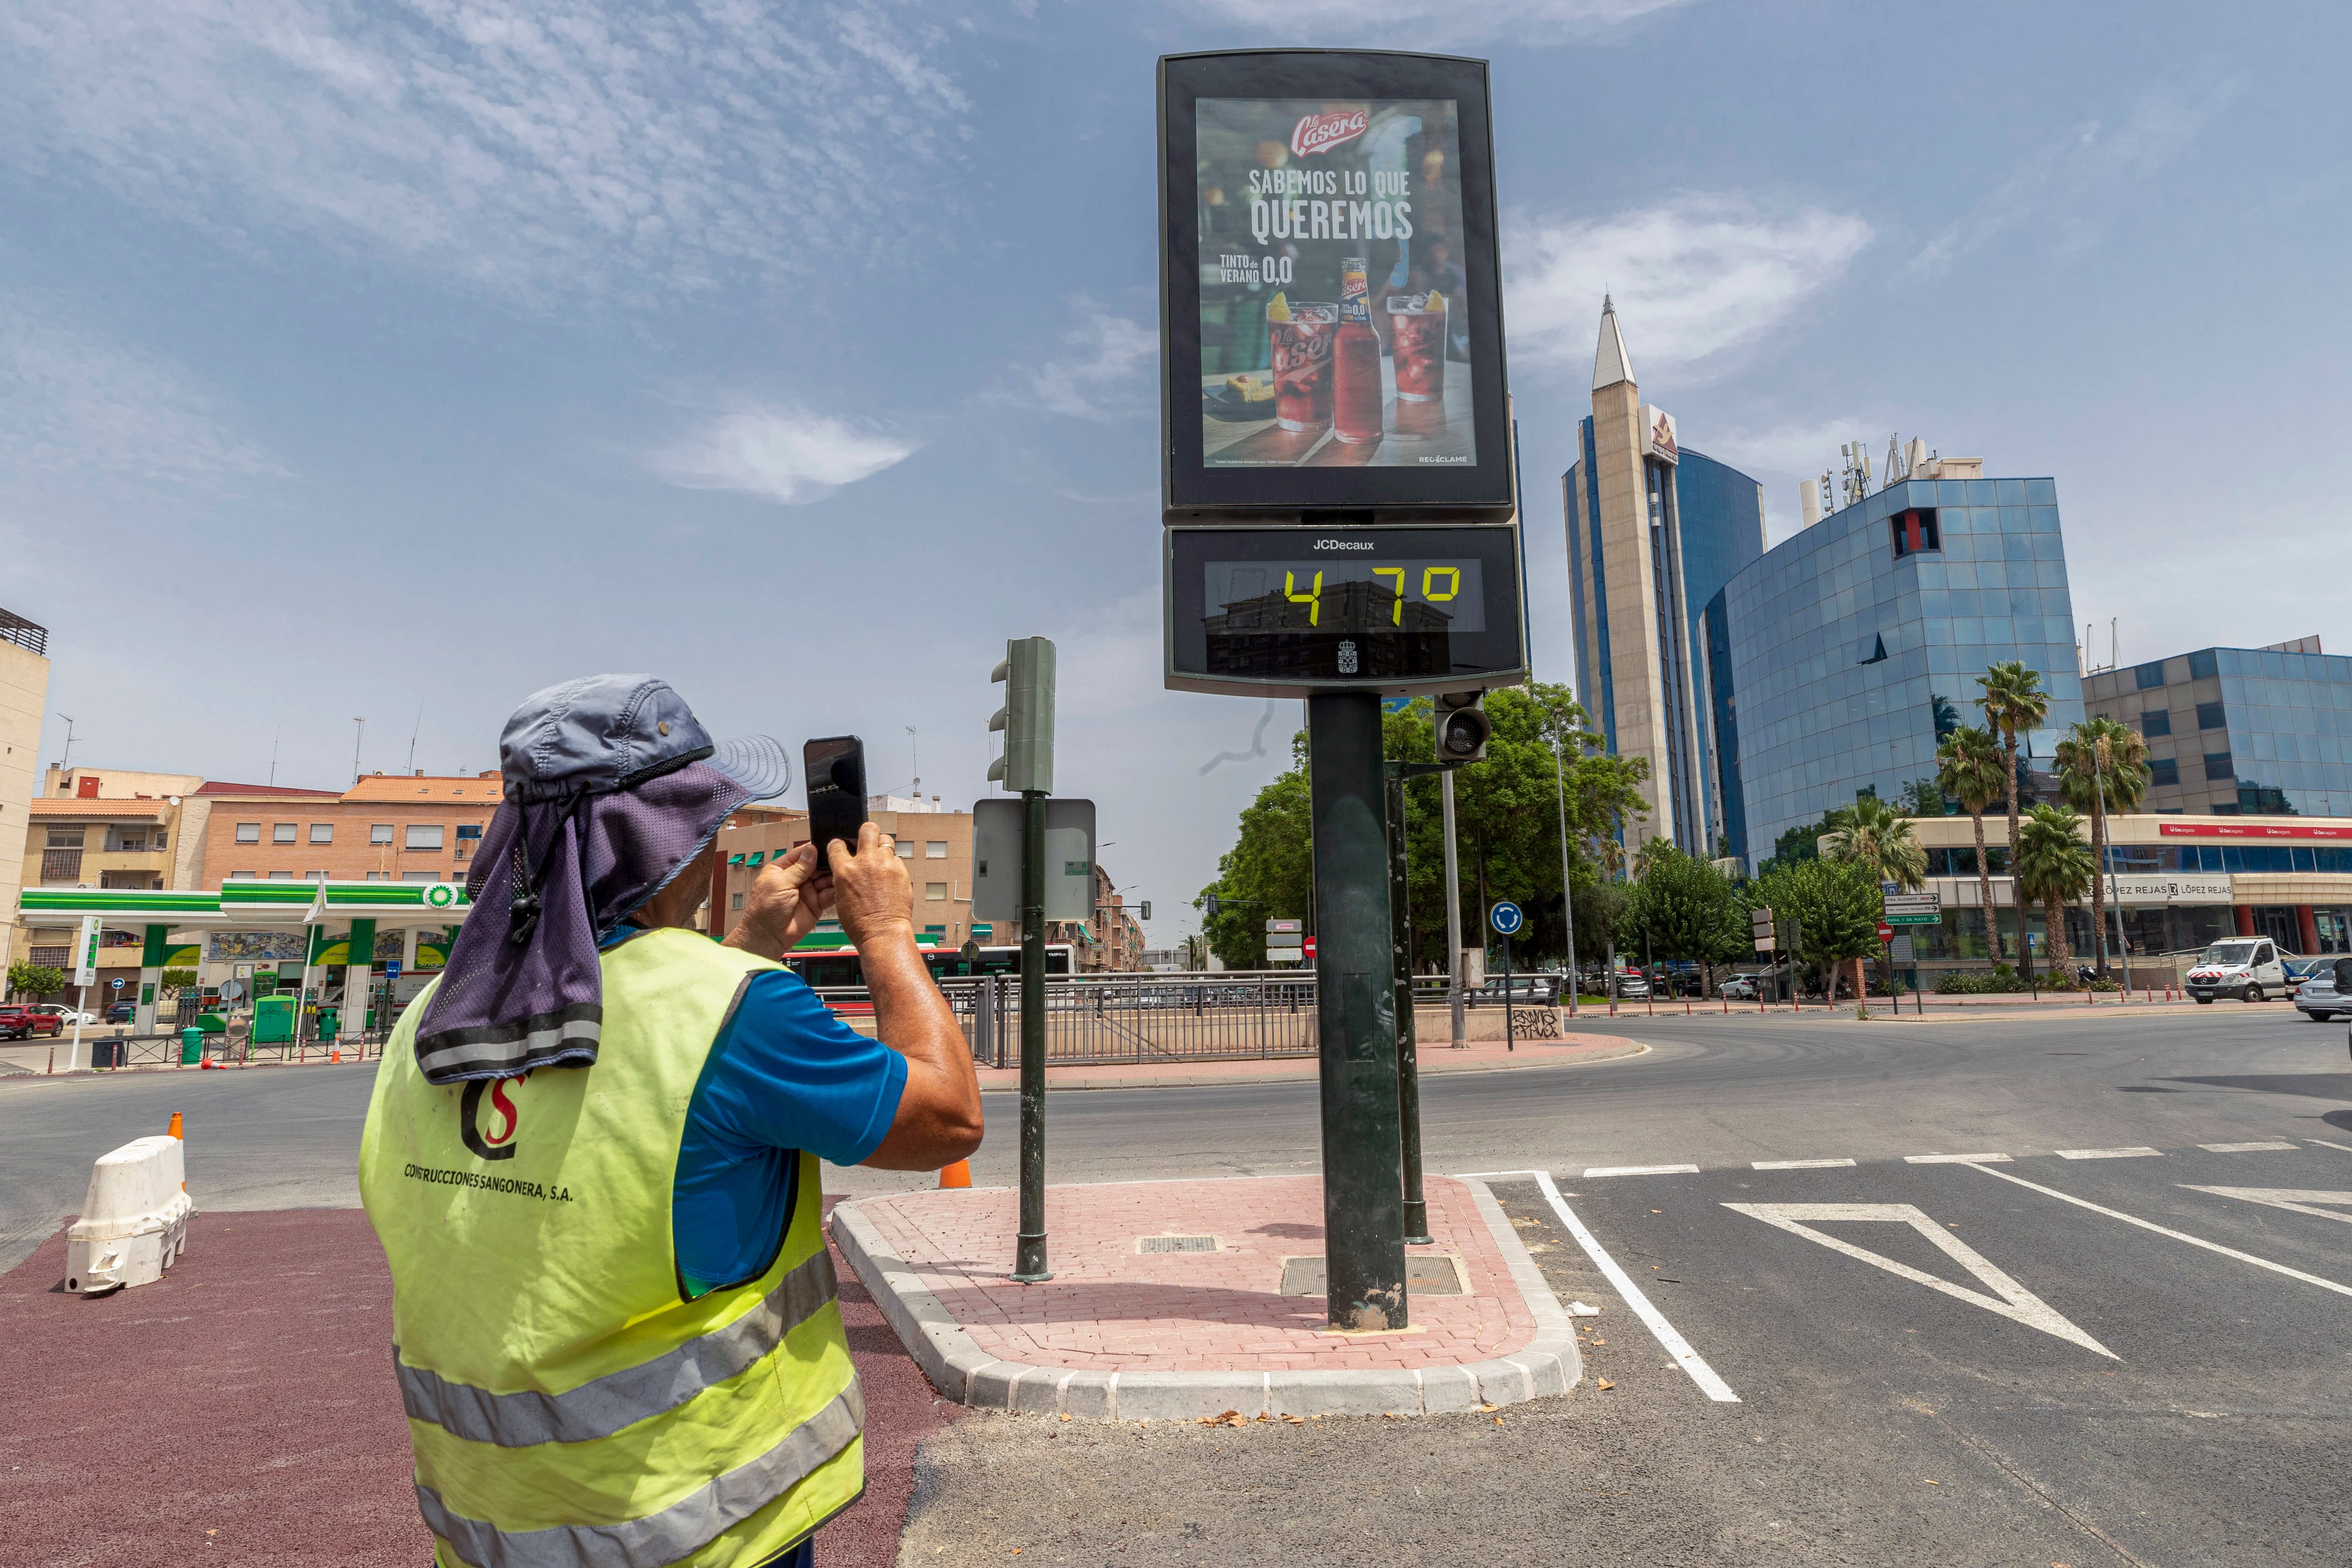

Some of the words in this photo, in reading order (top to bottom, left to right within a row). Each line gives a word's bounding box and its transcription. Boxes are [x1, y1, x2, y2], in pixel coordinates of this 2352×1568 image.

[1309, 114, 1320, 128] La
[1292, 110, 1367, 157] Casera
[1249, 169, 1337, 195] SABEMOS
[1345, 170, 1367, 195] LO
[1374, 171, 1411, 197] QUE
[1250, 200, 1413, 245] QUEREMOS
[1220, 254, 1249, 268] TINTO
[1250, 260, 1258, 268] de
[1220, 269, 1259, 283] VERANO
[1262, 256, 1292, 286] 0,0
[1353, 304, 1365, 316] 0,0
[1281, 328, 1294, 345] La
[1313, 539, 1375, 551] JCDecaux
[405, 1163, 479, 1188] CONSTRUCCIONES
[479, 1175, 547, 1201] SANGONERA,
[550, 1185, 573, 1202] S.A.
